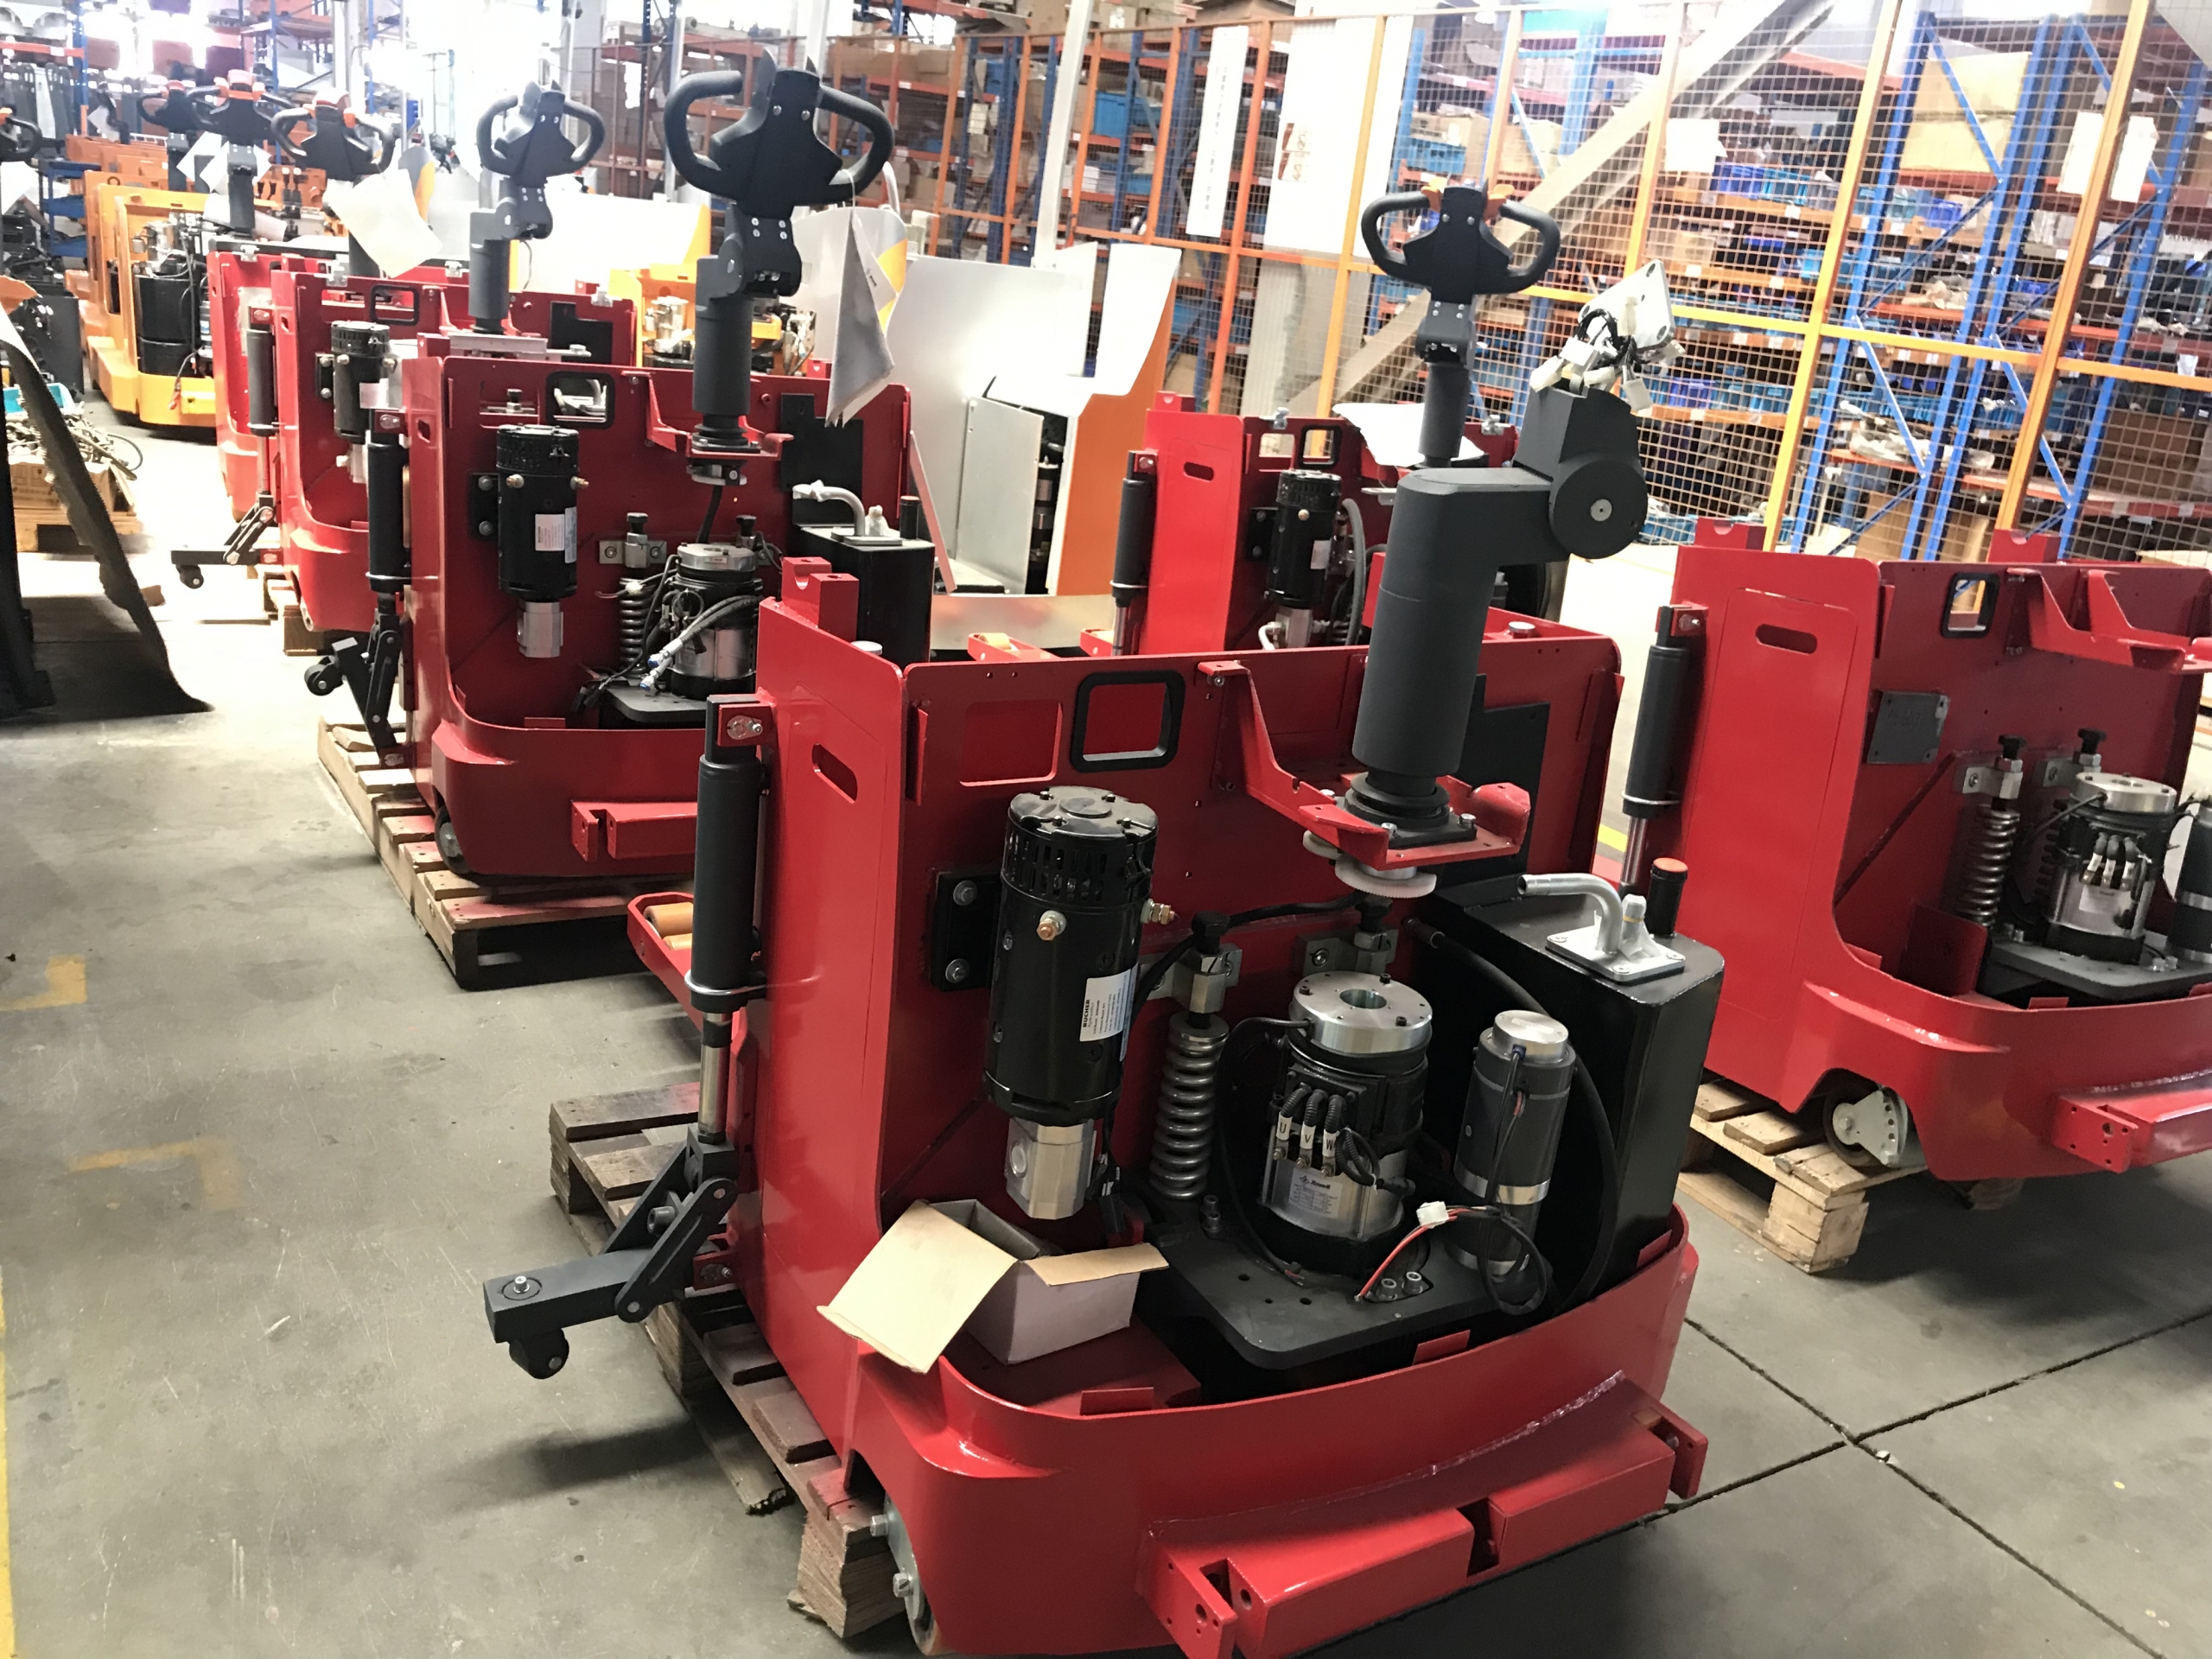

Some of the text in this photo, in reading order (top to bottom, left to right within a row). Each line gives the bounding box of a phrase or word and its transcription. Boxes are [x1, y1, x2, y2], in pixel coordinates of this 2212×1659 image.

[1280, 1122, 1287, 1133] U
[1305, 1135, 1311, 1143] V
[1326, 1140, 1334, 1150] W
